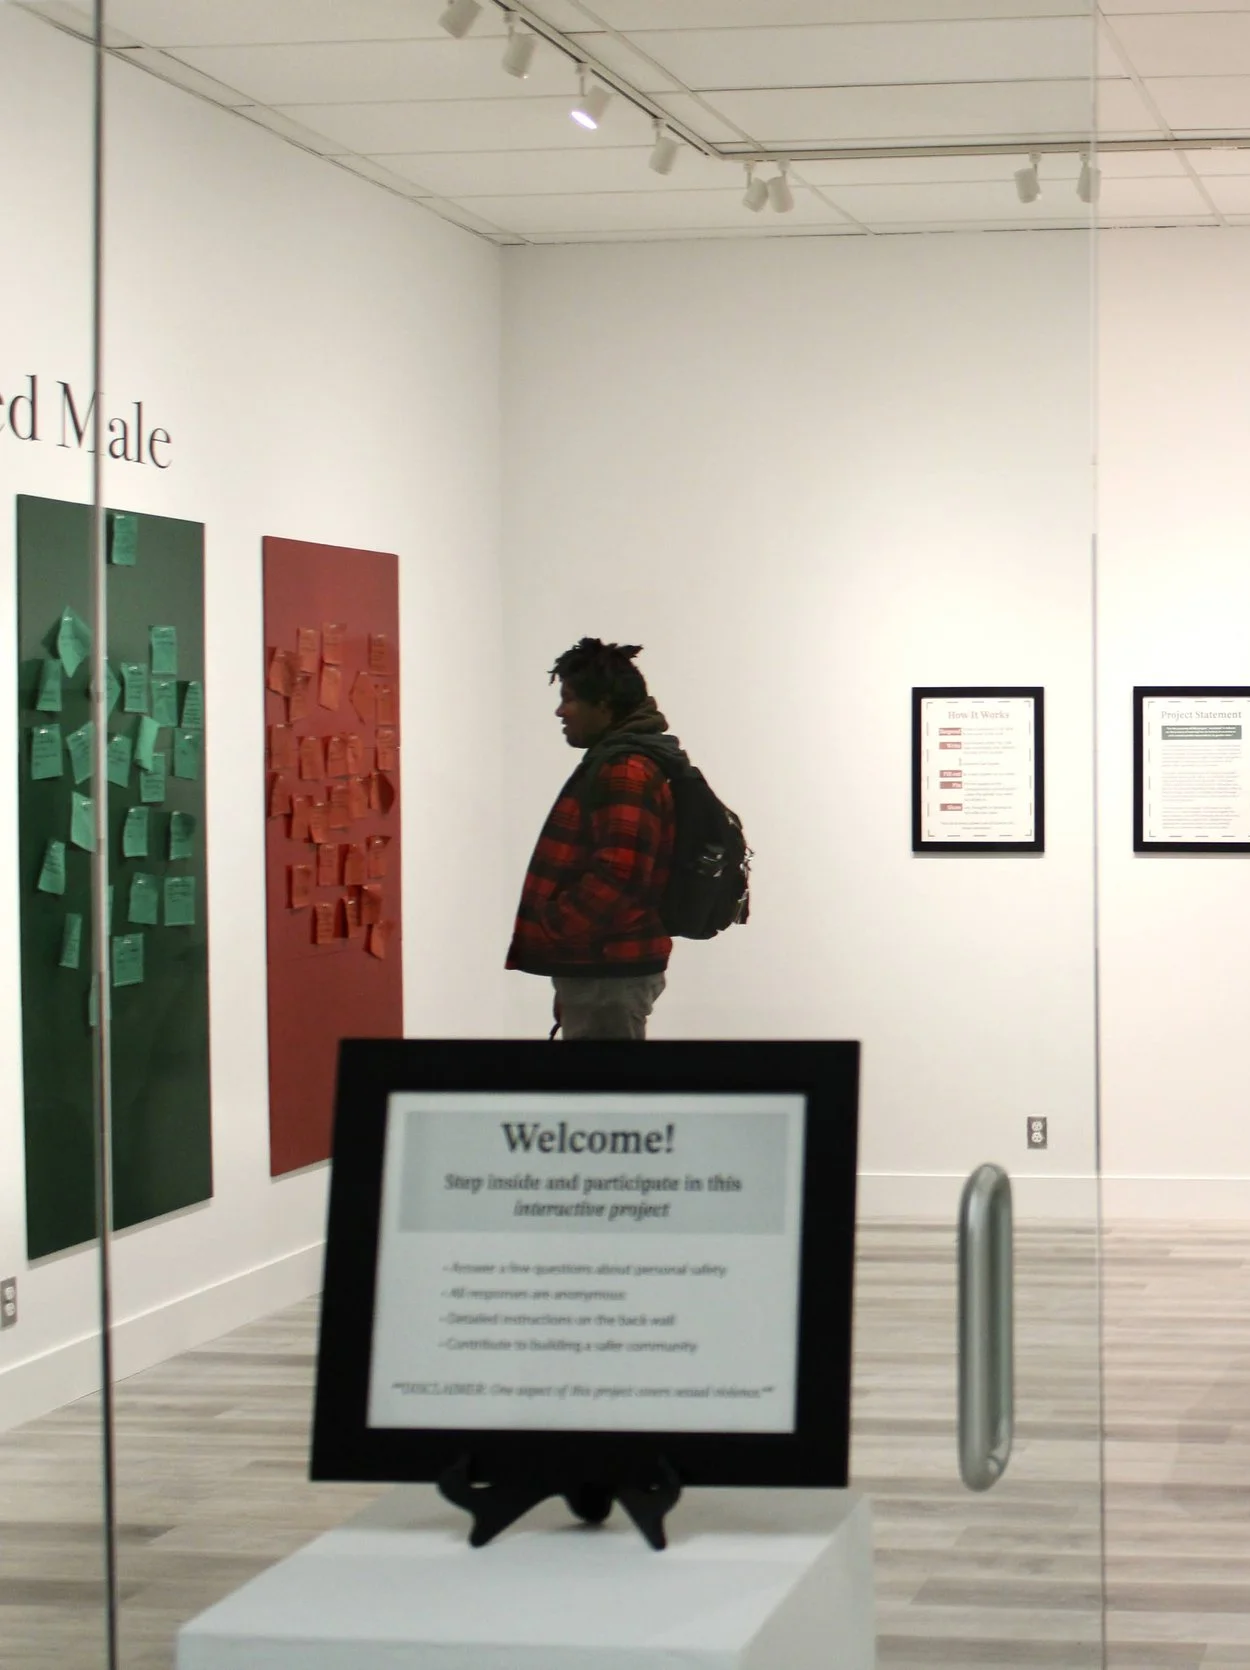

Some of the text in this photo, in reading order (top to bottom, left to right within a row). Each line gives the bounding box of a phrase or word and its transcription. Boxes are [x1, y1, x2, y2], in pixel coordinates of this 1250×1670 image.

[56, 380, 172, 469] Male
[948, 710, 1009, 719] How It Works
[1161, 710, 1242, 722] Project Statement
[501, 1121, 676, 1155] Welcome!
[444, 1174, 742, 1196] Step inside and participate in this
[513, 1200, 671, 1221] interactive project
[534, 1263, 593, 1277] questions
[596, 1263, 631, 1275] about
[634, 1263, 688, 1278] personal
[690, 1263, 727, 1279] safety
